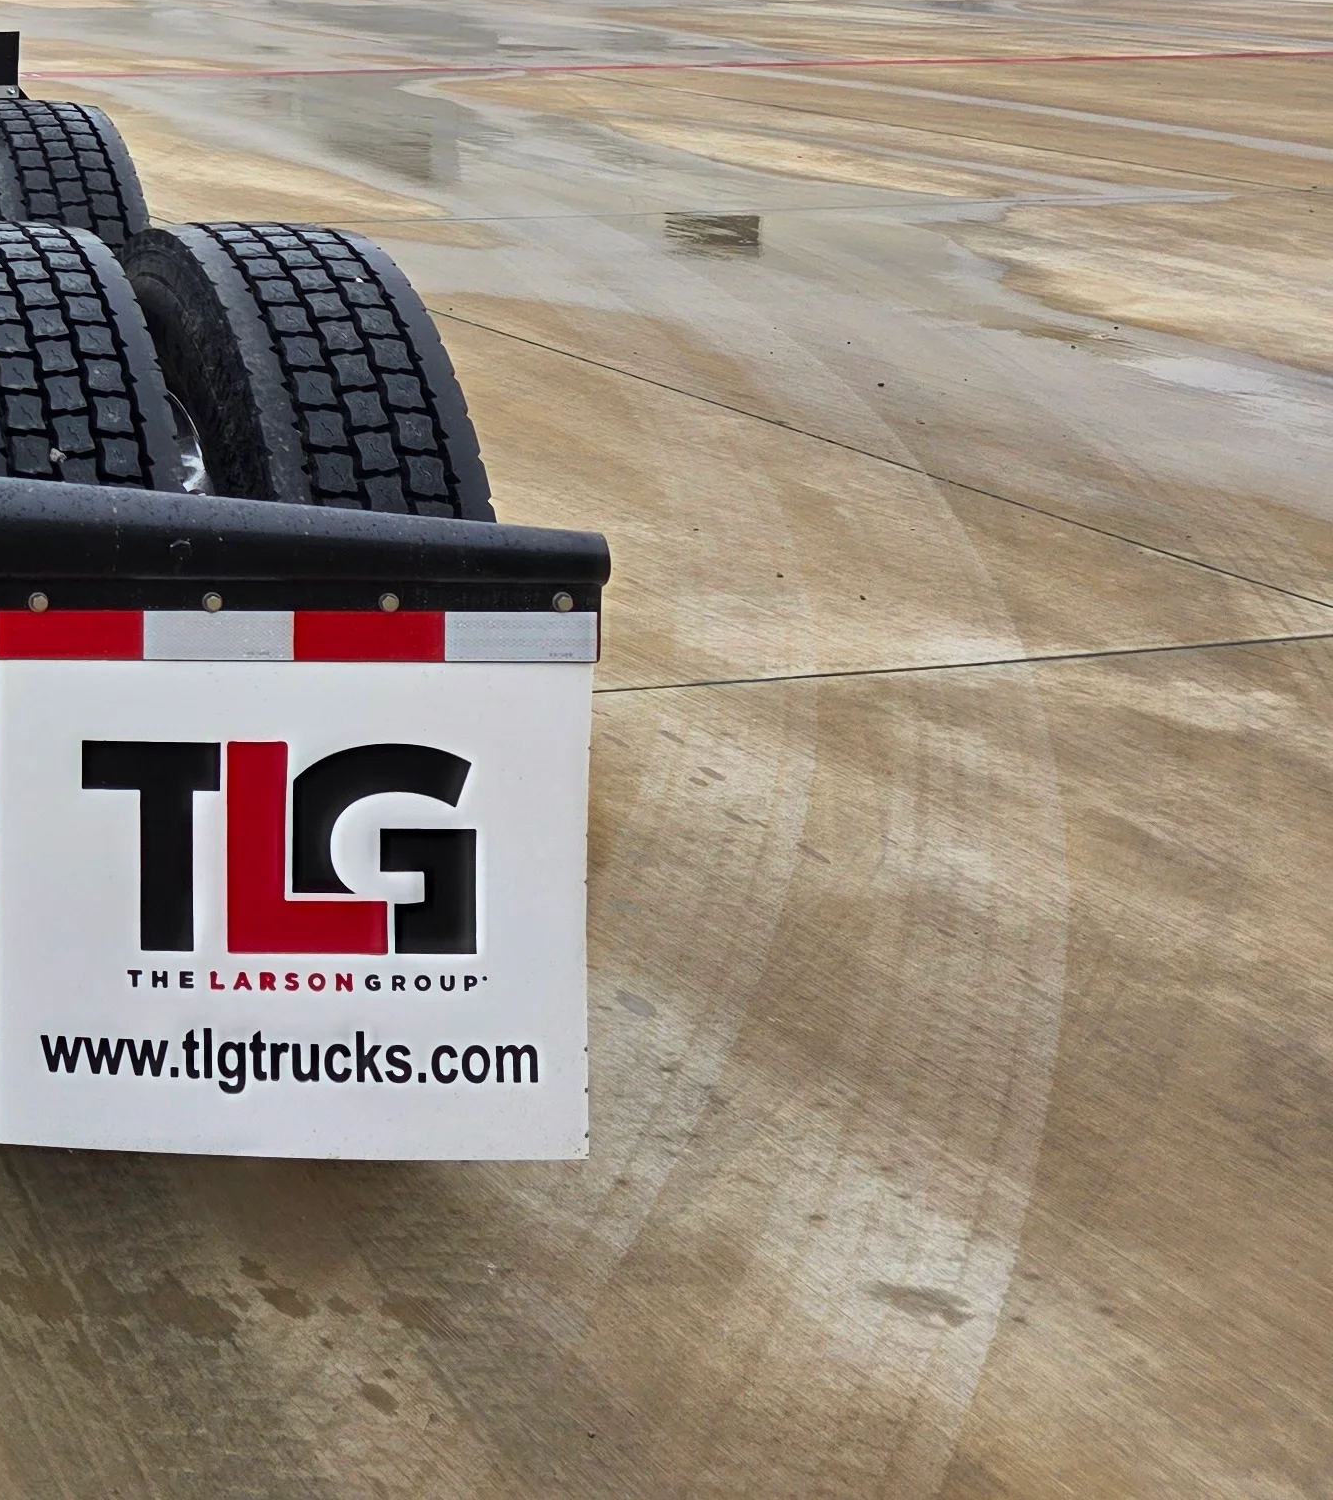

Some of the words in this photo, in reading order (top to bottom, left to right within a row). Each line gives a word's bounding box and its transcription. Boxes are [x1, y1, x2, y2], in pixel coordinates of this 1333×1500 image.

[82, 740, 477, 955] TLG
[127, 970, 194, 988] THE
[41, 1028, 538, 1094] www.tlgtrucks.com
